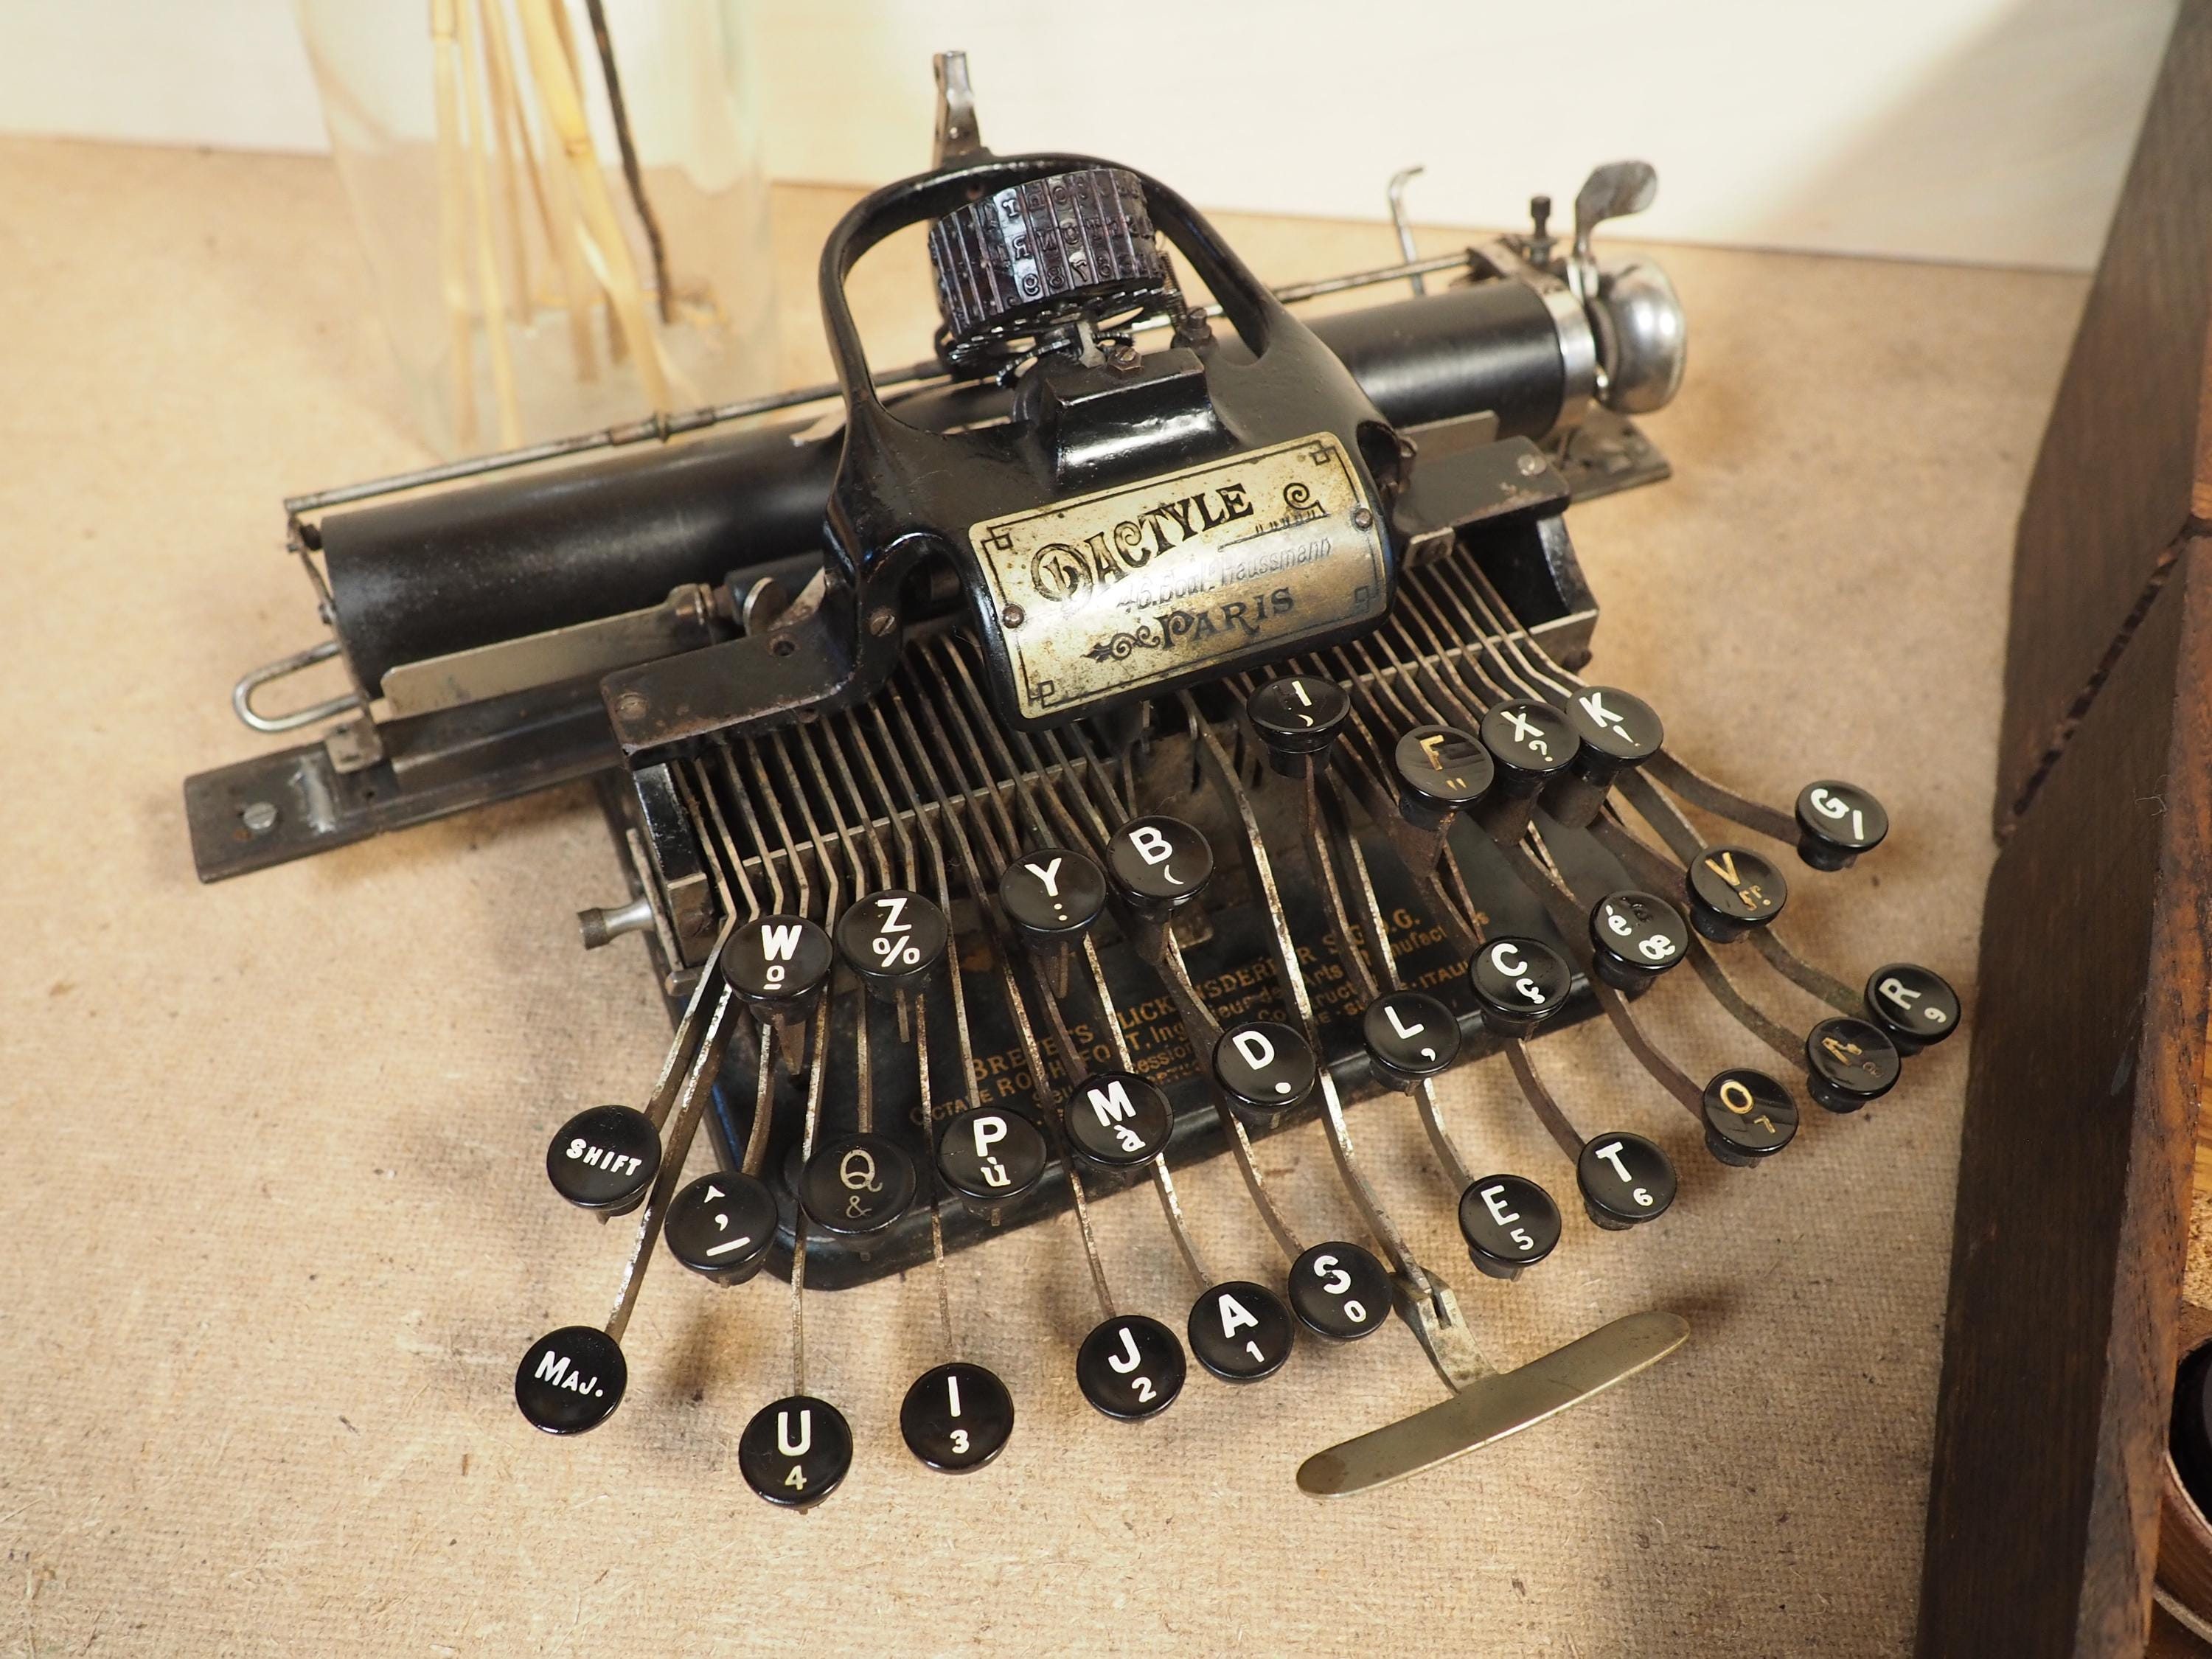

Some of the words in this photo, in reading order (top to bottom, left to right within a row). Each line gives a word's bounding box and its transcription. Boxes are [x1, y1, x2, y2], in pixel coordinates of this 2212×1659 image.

[1030, 483, 1253, 603] DACTYLE
[1154, 587, 1294, 650] PARIS
[1500, 712, 1543, 742] X
[1579, 692, 1624, 728] K
[1810, 788, 1849, 819] G
[1129, 826, 1173, 866] B
[1024, 858, 1062, 897] Y
[1705, 852, 1741, 886] V
[877, 897, 912, 933] Z
[761, 925, 802, 961] W
[1491, 943, 1528, 977] C
[1879, 978, 1921, 1010] R
[1384, 1006, 1425, 1040] L
[1232, 1030, 1275, 1071] D
[1088, 1080, 1136, 1127] M
[973, 1116, 1007, 1157] P
[566, 1138, 642, 1176] SHIFT
[840, 1149, 883, 1192] Q
[1595, 1141, 1632, 1183] T
[1481, 1185, 1520, 1226] E
[1632, 1188, 1654, 1206] 6
[1509, 1228, 1534, 1251] 5
[1313, 1255, 1352, 1295] S
[1218, 1293, 1259, 1339] A
[1107, 1327, 1141, 1374] J
[1246, 1340, 1265, 1363] 1
[947, 1376, 961, 1417] I
[1131, 1377, 1157, 1402] 2
[777, 1409, 811, 1456] U
[950, 1429, 970, 1454] 3
[785, 1464, 807, 1490] 4
